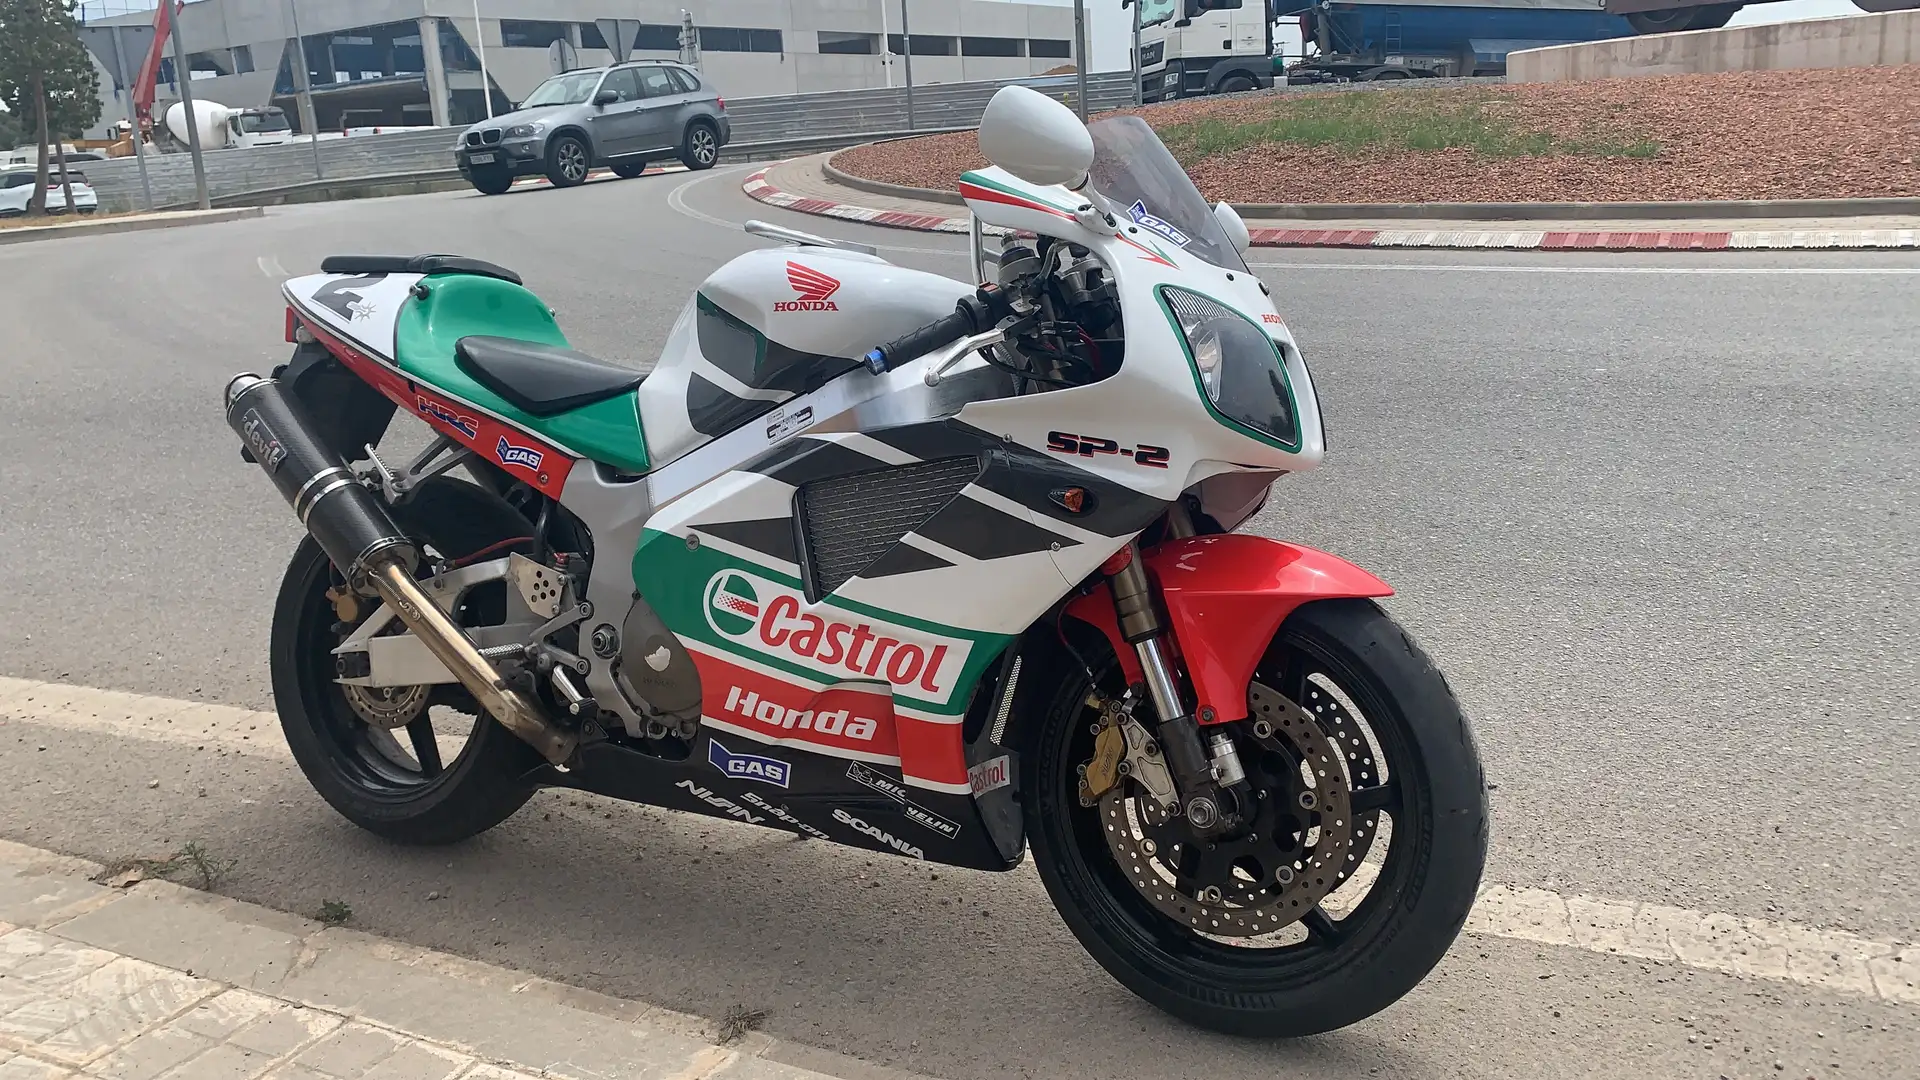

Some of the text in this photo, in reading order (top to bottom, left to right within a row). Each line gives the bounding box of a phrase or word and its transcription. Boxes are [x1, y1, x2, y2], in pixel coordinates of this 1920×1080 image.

[1138, 216, 1187, 244] GAS
[773, 301, 839, 312] HONDA
[417, 394, 479, 440] HRC
[243, 419, 281, 466] devil
[505, 449, 541, 467] GAS
[1047, 430, 1171, 469] SP-2
[759, 595, 948, 693] Castrol
[723, 685, 878, 741] Honda
[728, 759, 783, 781] GAS
[832, 808, 925, 861] SCANIA
